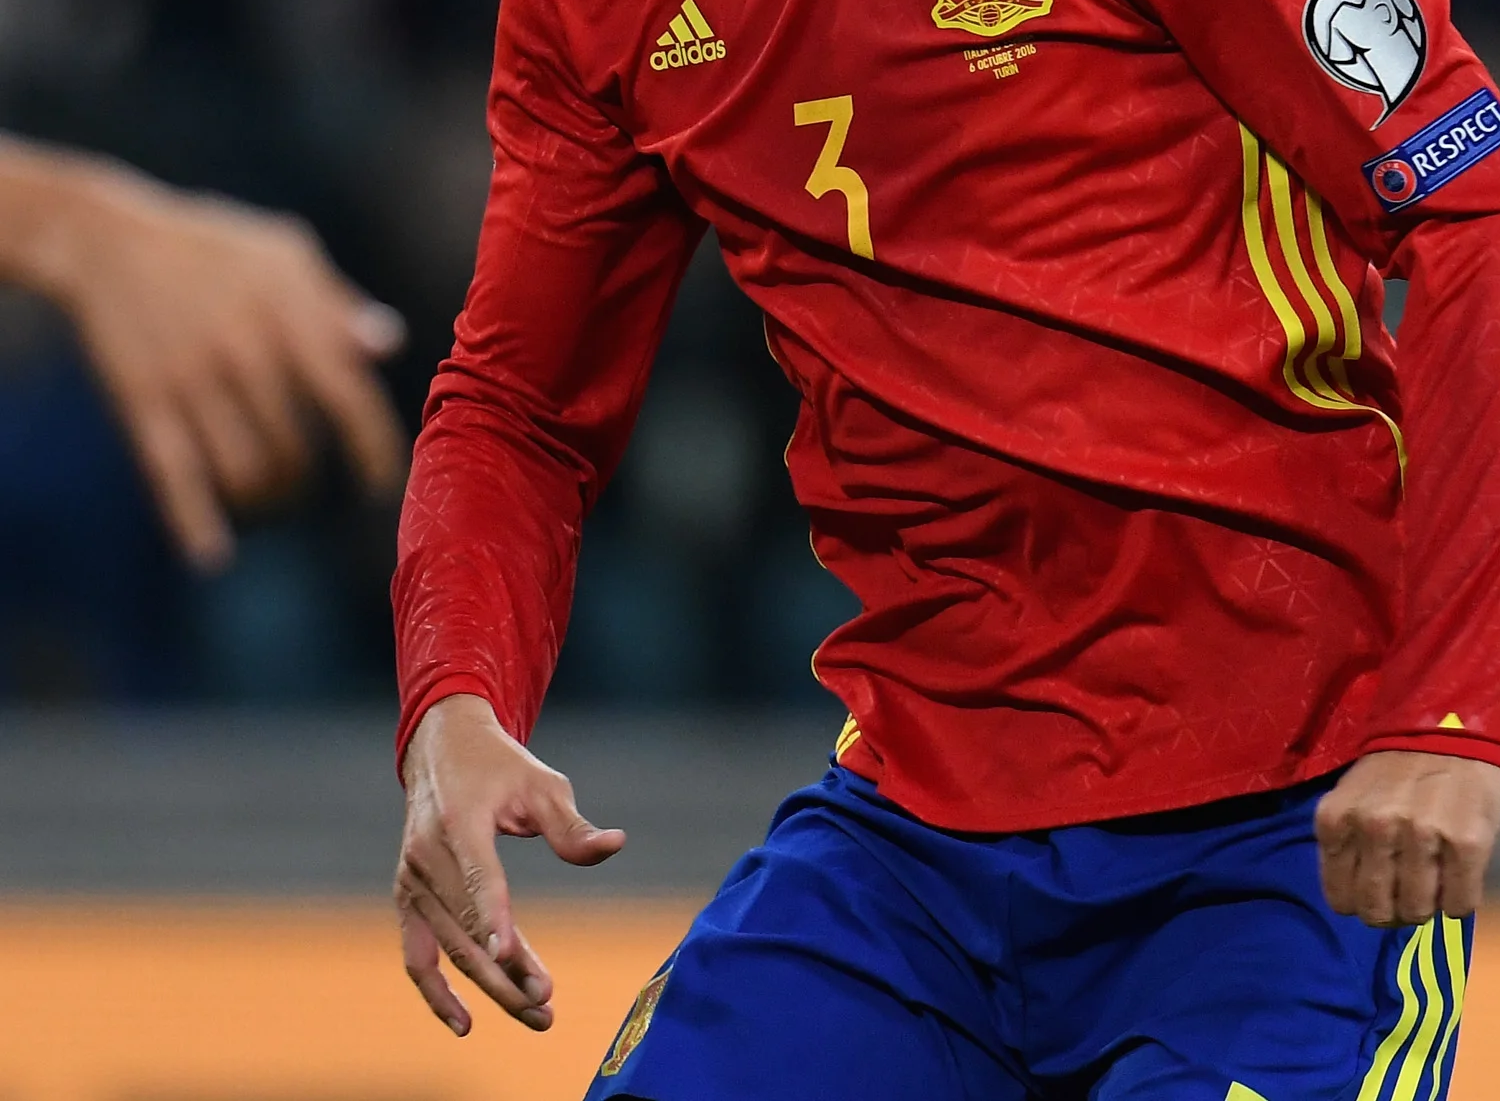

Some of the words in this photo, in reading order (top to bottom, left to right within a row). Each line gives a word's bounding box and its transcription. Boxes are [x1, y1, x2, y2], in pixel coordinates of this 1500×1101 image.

[650, 39, 726, 70] adidas
[969, 63, 976, 73] 6
[977, 51, 1014, 70] OCTUBRE
[1015, 44, 1036, 58] 2016
[794, 95, 874, 260] 3
